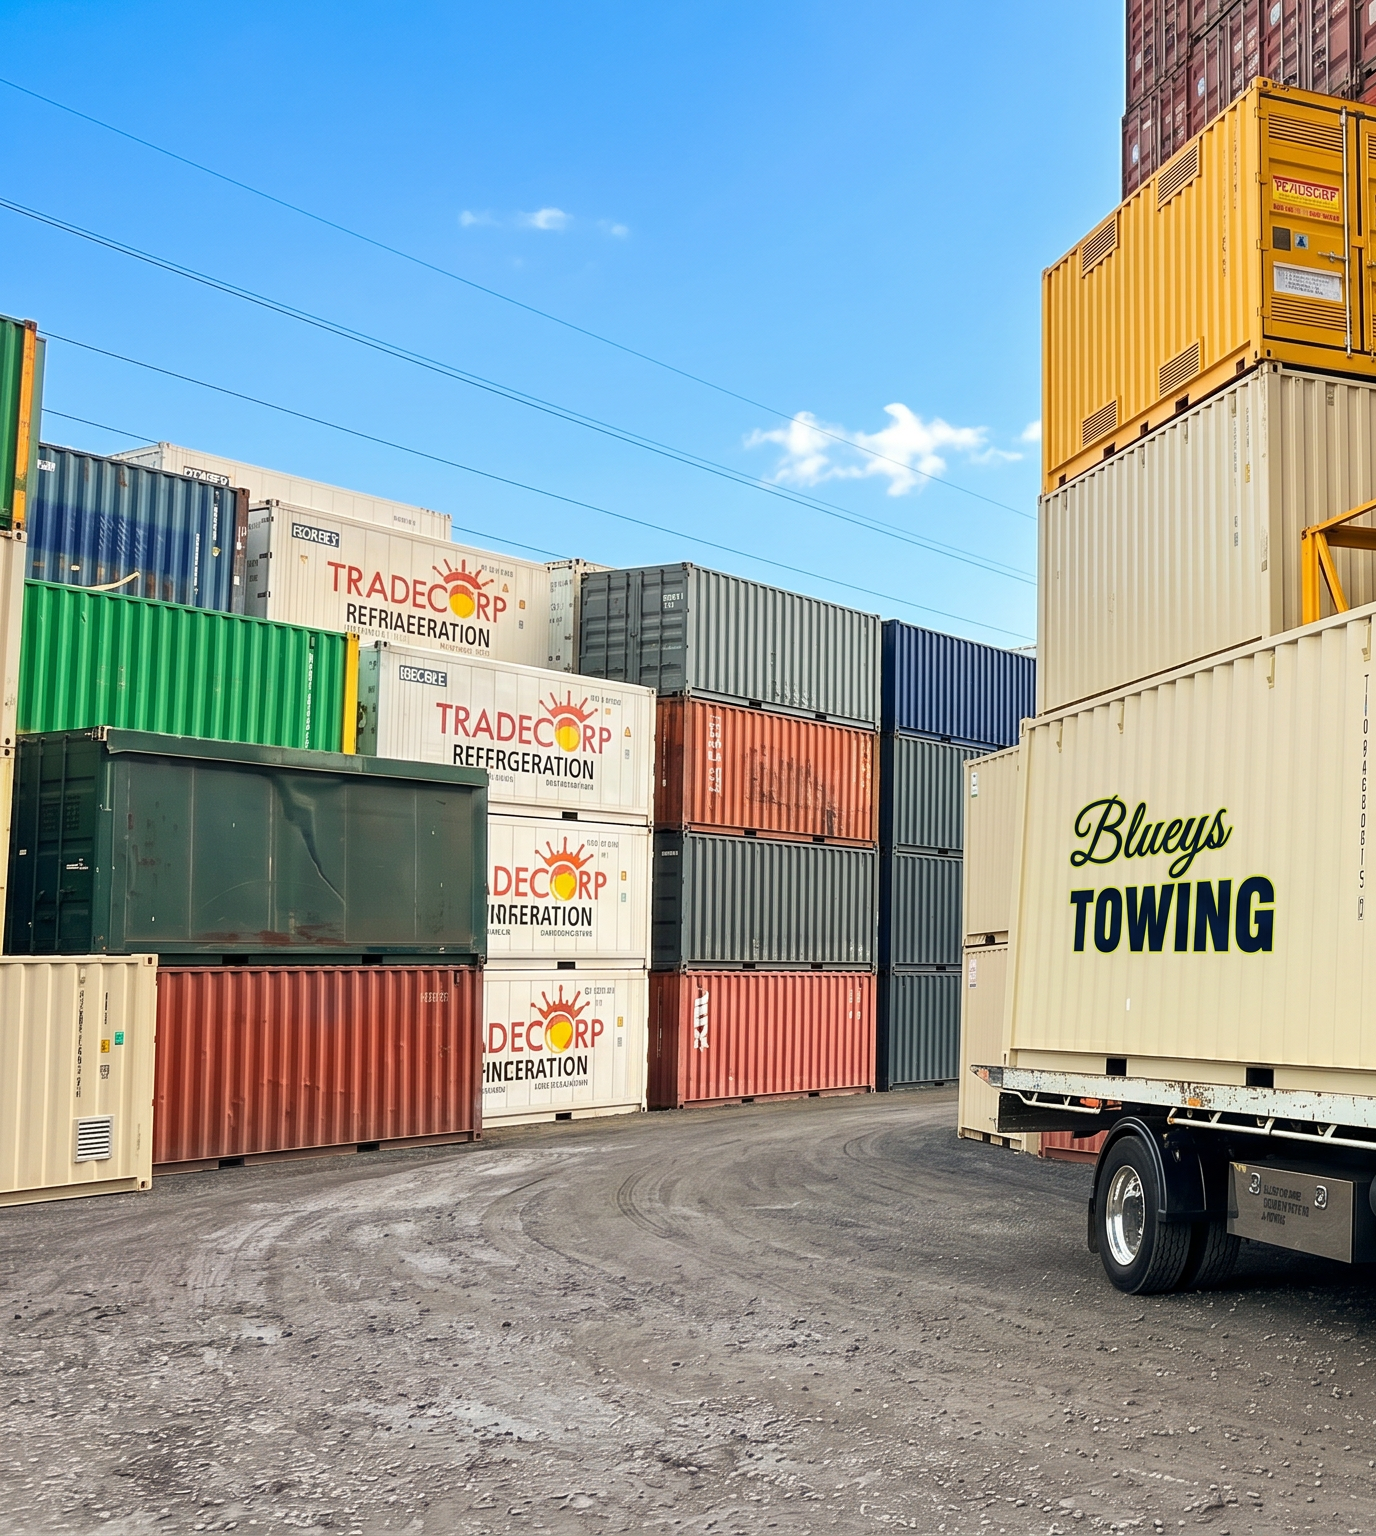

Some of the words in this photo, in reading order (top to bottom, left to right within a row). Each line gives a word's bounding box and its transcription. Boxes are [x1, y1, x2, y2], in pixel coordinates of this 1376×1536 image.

[327, 561, 507, 623] TRADECORP
[436, 702, 612, 754] TRADECORP
[1070, 794, 1233, 879] Blueys
[1070, 875, 1275, 953] TOWING
